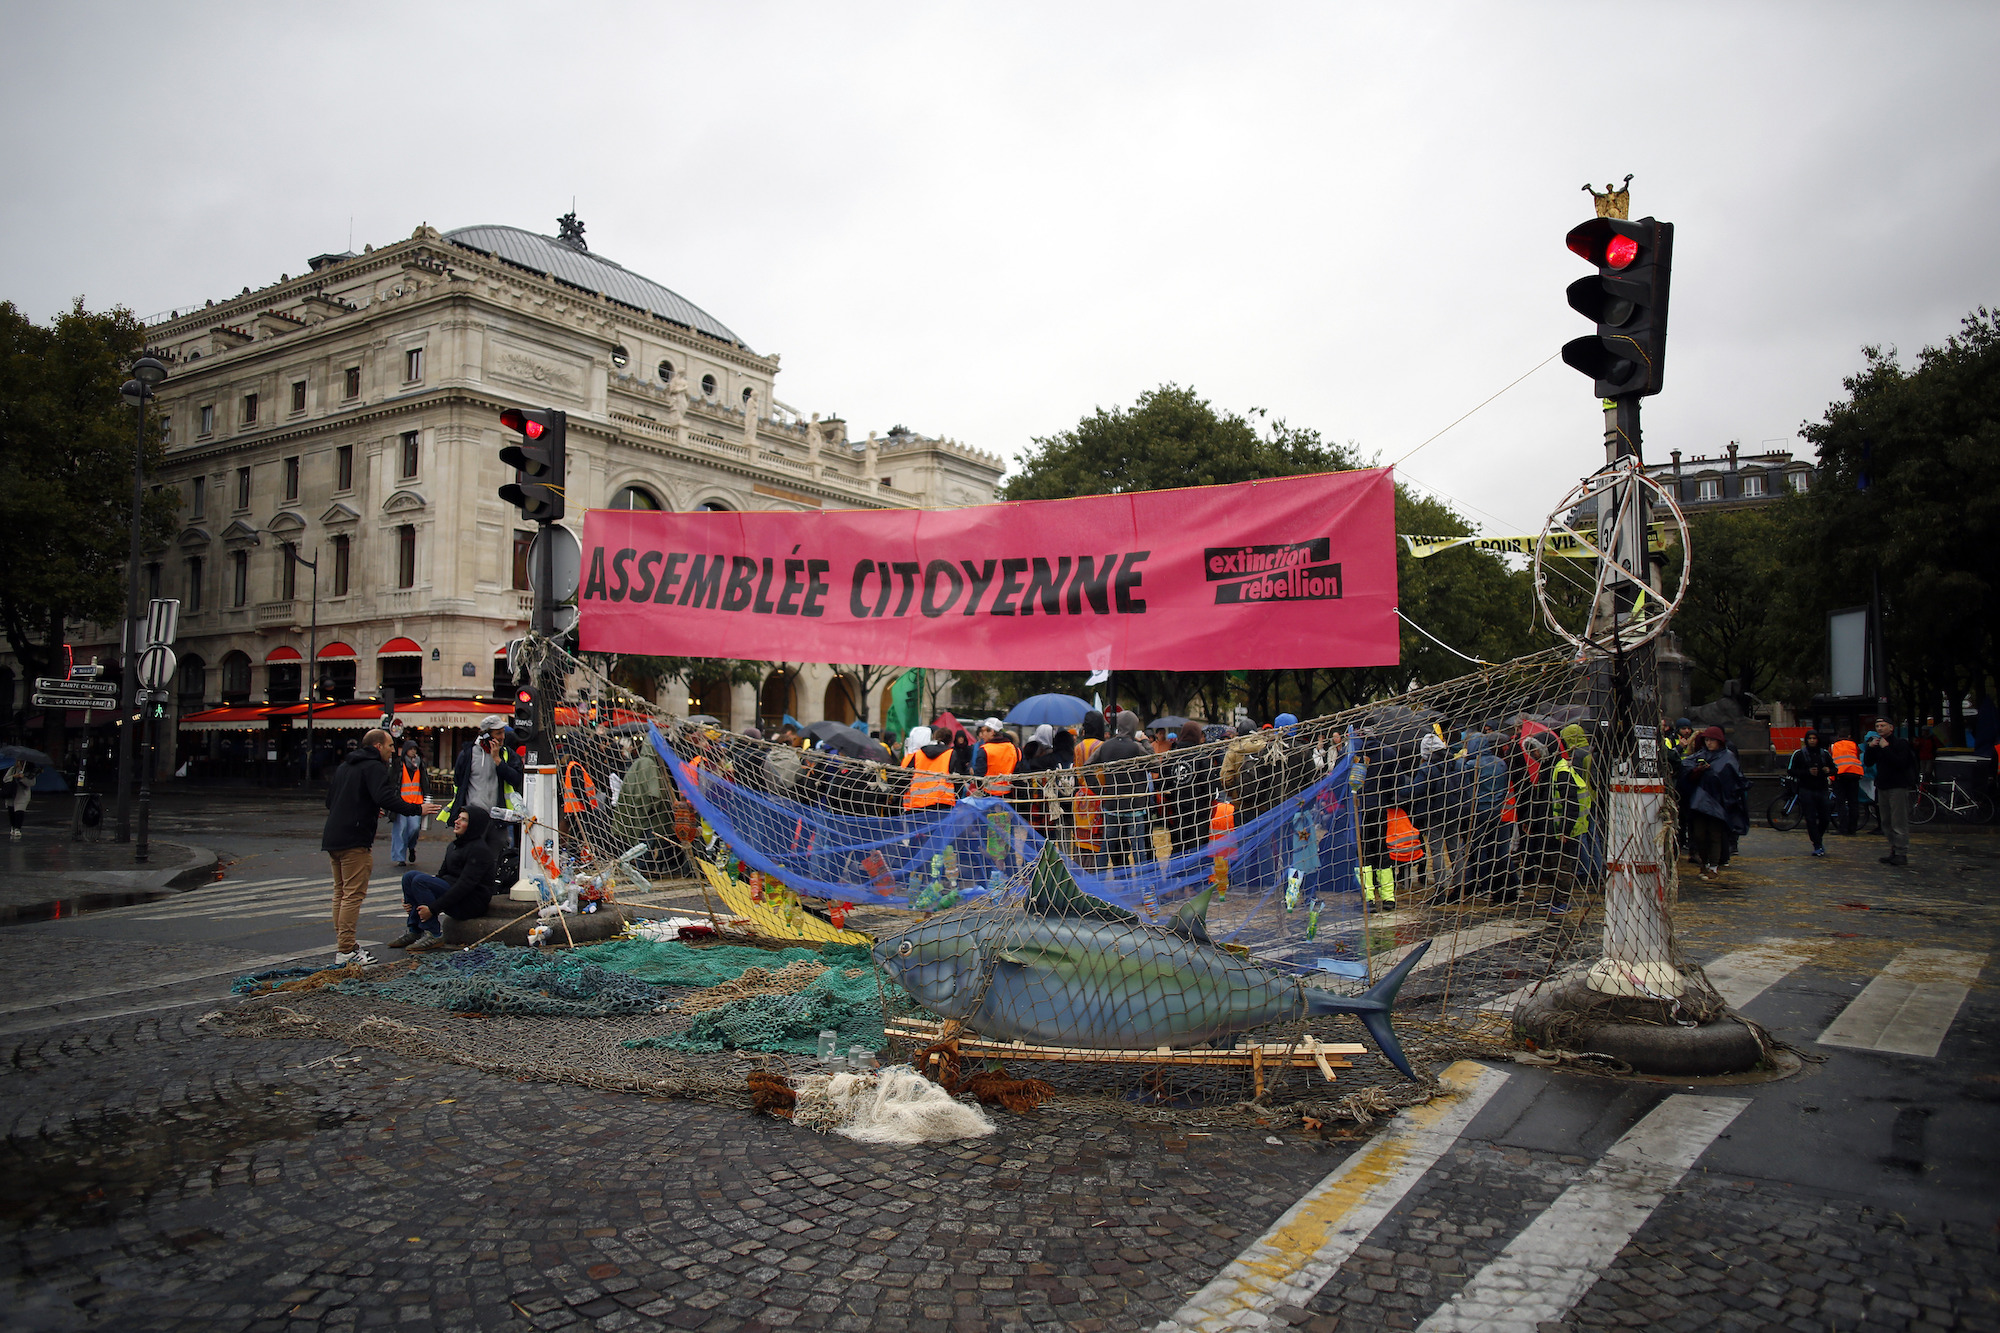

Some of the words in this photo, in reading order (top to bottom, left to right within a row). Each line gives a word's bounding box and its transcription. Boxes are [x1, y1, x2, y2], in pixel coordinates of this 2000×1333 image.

[1481, 539, 1522, 553] POUR
[1551, 536, 1577, 550] VIE
[1209, 546, 1311, 573] extinction
[584, 545, 829, 617] ASSEMBLÉE
[850, 551, 1151, 618] CITOYENNE
[1239, 568, 1338, 600] rebellion
[60, 681, 79, 689] SAINTE
[81, 683, 106, 691] CHAPELLE
